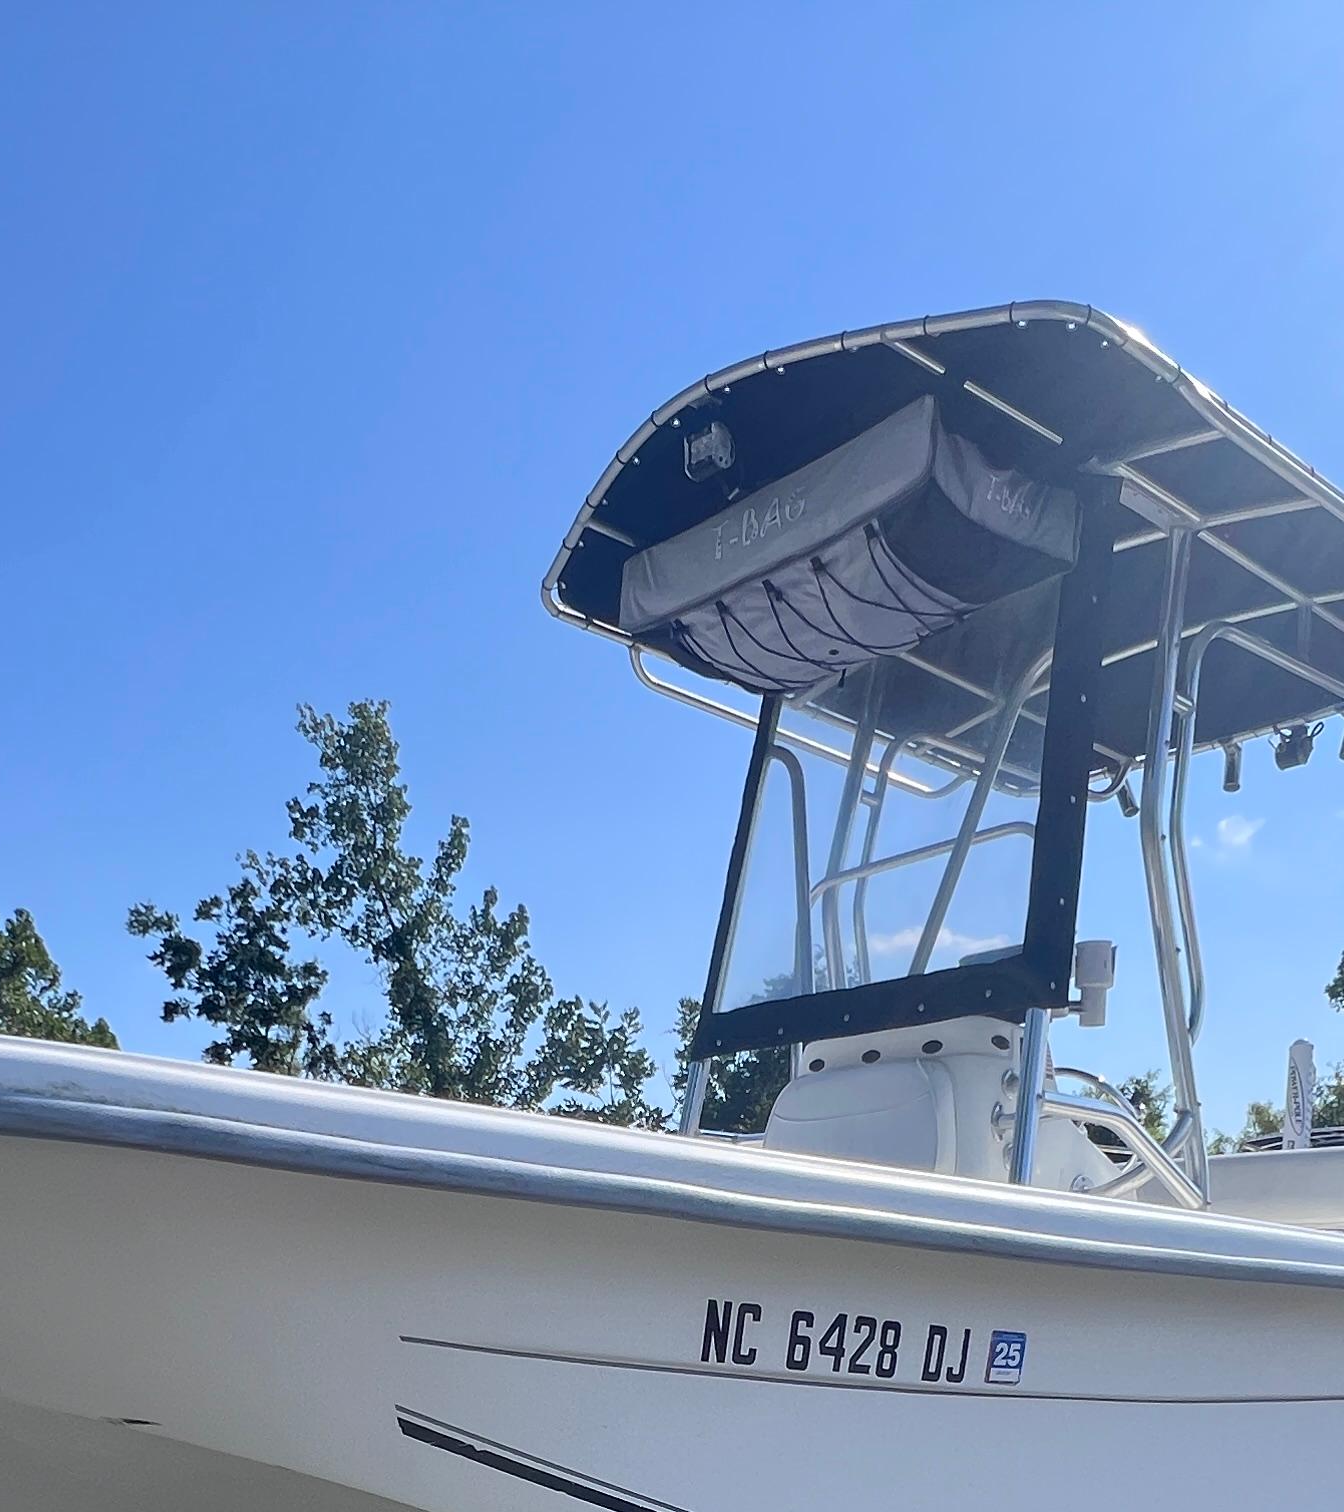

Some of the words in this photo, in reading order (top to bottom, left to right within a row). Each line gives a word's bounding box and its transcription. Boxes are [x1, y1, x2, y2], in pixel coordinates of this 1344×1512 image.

[712, 486, 807, 560] T-BAG
[701, 1299, 762, 1366] NC
[786, 1310, 902, 1379] 6428
[921, 1324, 972, 1384] DJ
[993, 1342, 1022, 1367] 25
